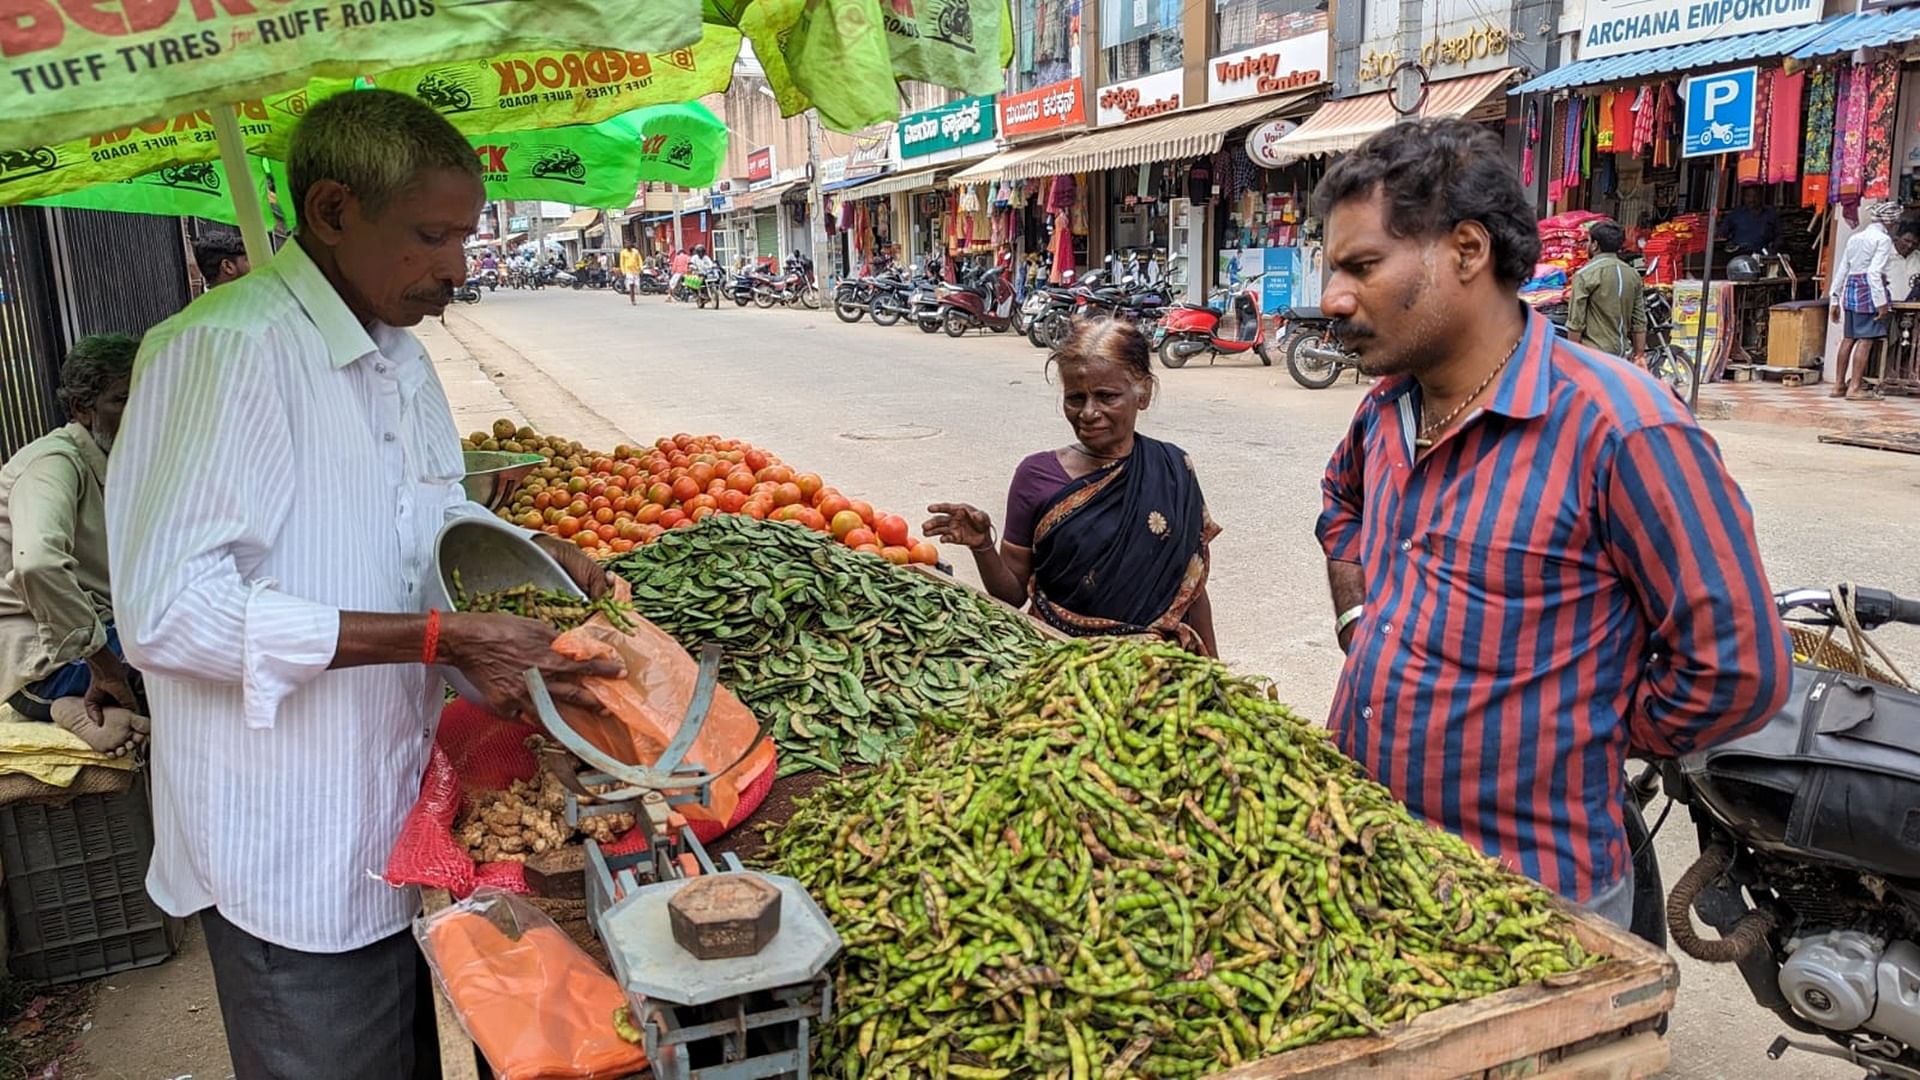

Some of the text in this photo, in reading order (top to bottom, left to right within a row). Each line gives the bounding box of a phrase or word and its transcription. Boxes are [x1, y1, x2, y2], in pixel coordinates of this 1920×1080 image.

[1586, 9, 1680, 47] ARCHANA
[11, 53, 107, 95] TUFF
[116, 29, 222, 74] TYRES
[257, 8, 330, 45] RUFF
[341, 0, 435, 28] ROADS
[1215, 53, 1281, 84] Variety
[1256, 69, 1321, 95] Centre
[1704, 79, 1740, 121] P
